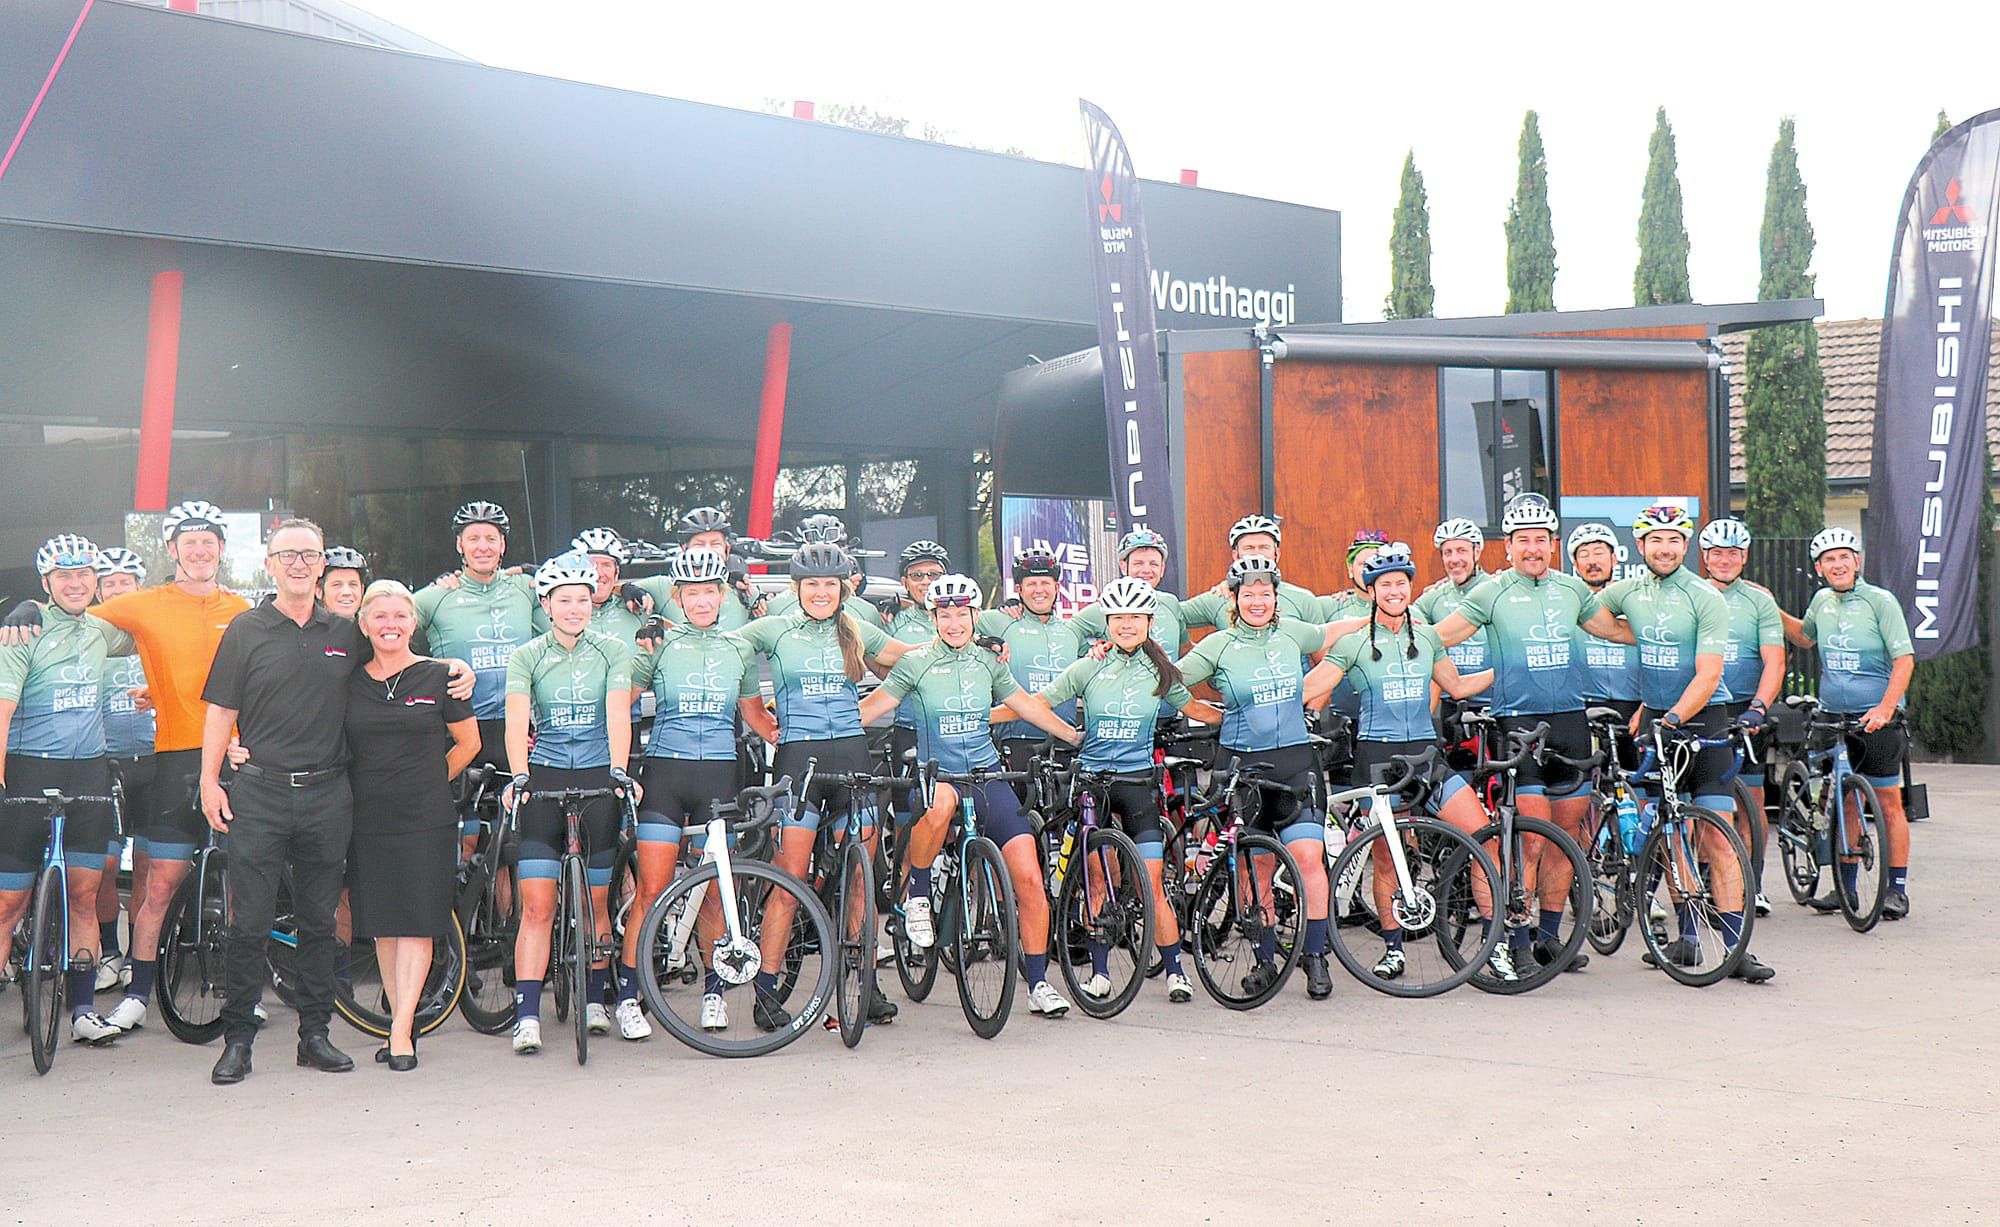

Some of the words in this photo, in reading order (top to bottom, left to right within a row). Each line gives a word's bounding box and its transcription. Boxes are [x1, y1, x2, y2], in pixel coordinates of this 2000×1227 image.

[1927, 238, 1980, 253] MOTORS
[1914, 277, 1962, 639] MITSUBISHI
[471, 645, 495, 657] RIDE
[1526, 645, 1550, 655] RIDE
[1552, 643, 1570, 653] FOR
[1660, 646, 1679, 655] FOR
[472, 654, 510, 670] RELIE
[1527, 652, 1570, 667] RELIEF
[1587, 655, 1626, 666] RELIEF
[1641, 653, 1680, 667] RELIEF
[800, 675, 824, 685] RIDE
[1251, 681, 1276, 693] RIDE
[1277, 678, 1297, 688] FOR
[1382, 680, 1404, 691] RIDE
[1407, 678, 1424, 687] FOR
[802, 683, 844, 695] RELIEF
[1253, 686, 1297, 704] RELIEF
[1383, 687, 1424, 701] RELIEF
[679, 692, 704, 702] RIDE
[706, 693, 727, 702] FOR
[53, 695, 97, 713] RELIEF
[679, 701, 726, 713] RELIEF
[550, 706, 573, 717] RIDE
[576, 705, 596, 714] FOR
[551, 713, 595, 727] RELIEF
[939, 713, 964, 724] RIDE
[1098, 720, 1119, 729] RIDE
[1121, 720, 1141, 729] FOR
[939, 720, 980, 734] RELIEF
[1097, 728, 1139, 739] RELIEF
[803, 994, 821, 1020] SWISS
